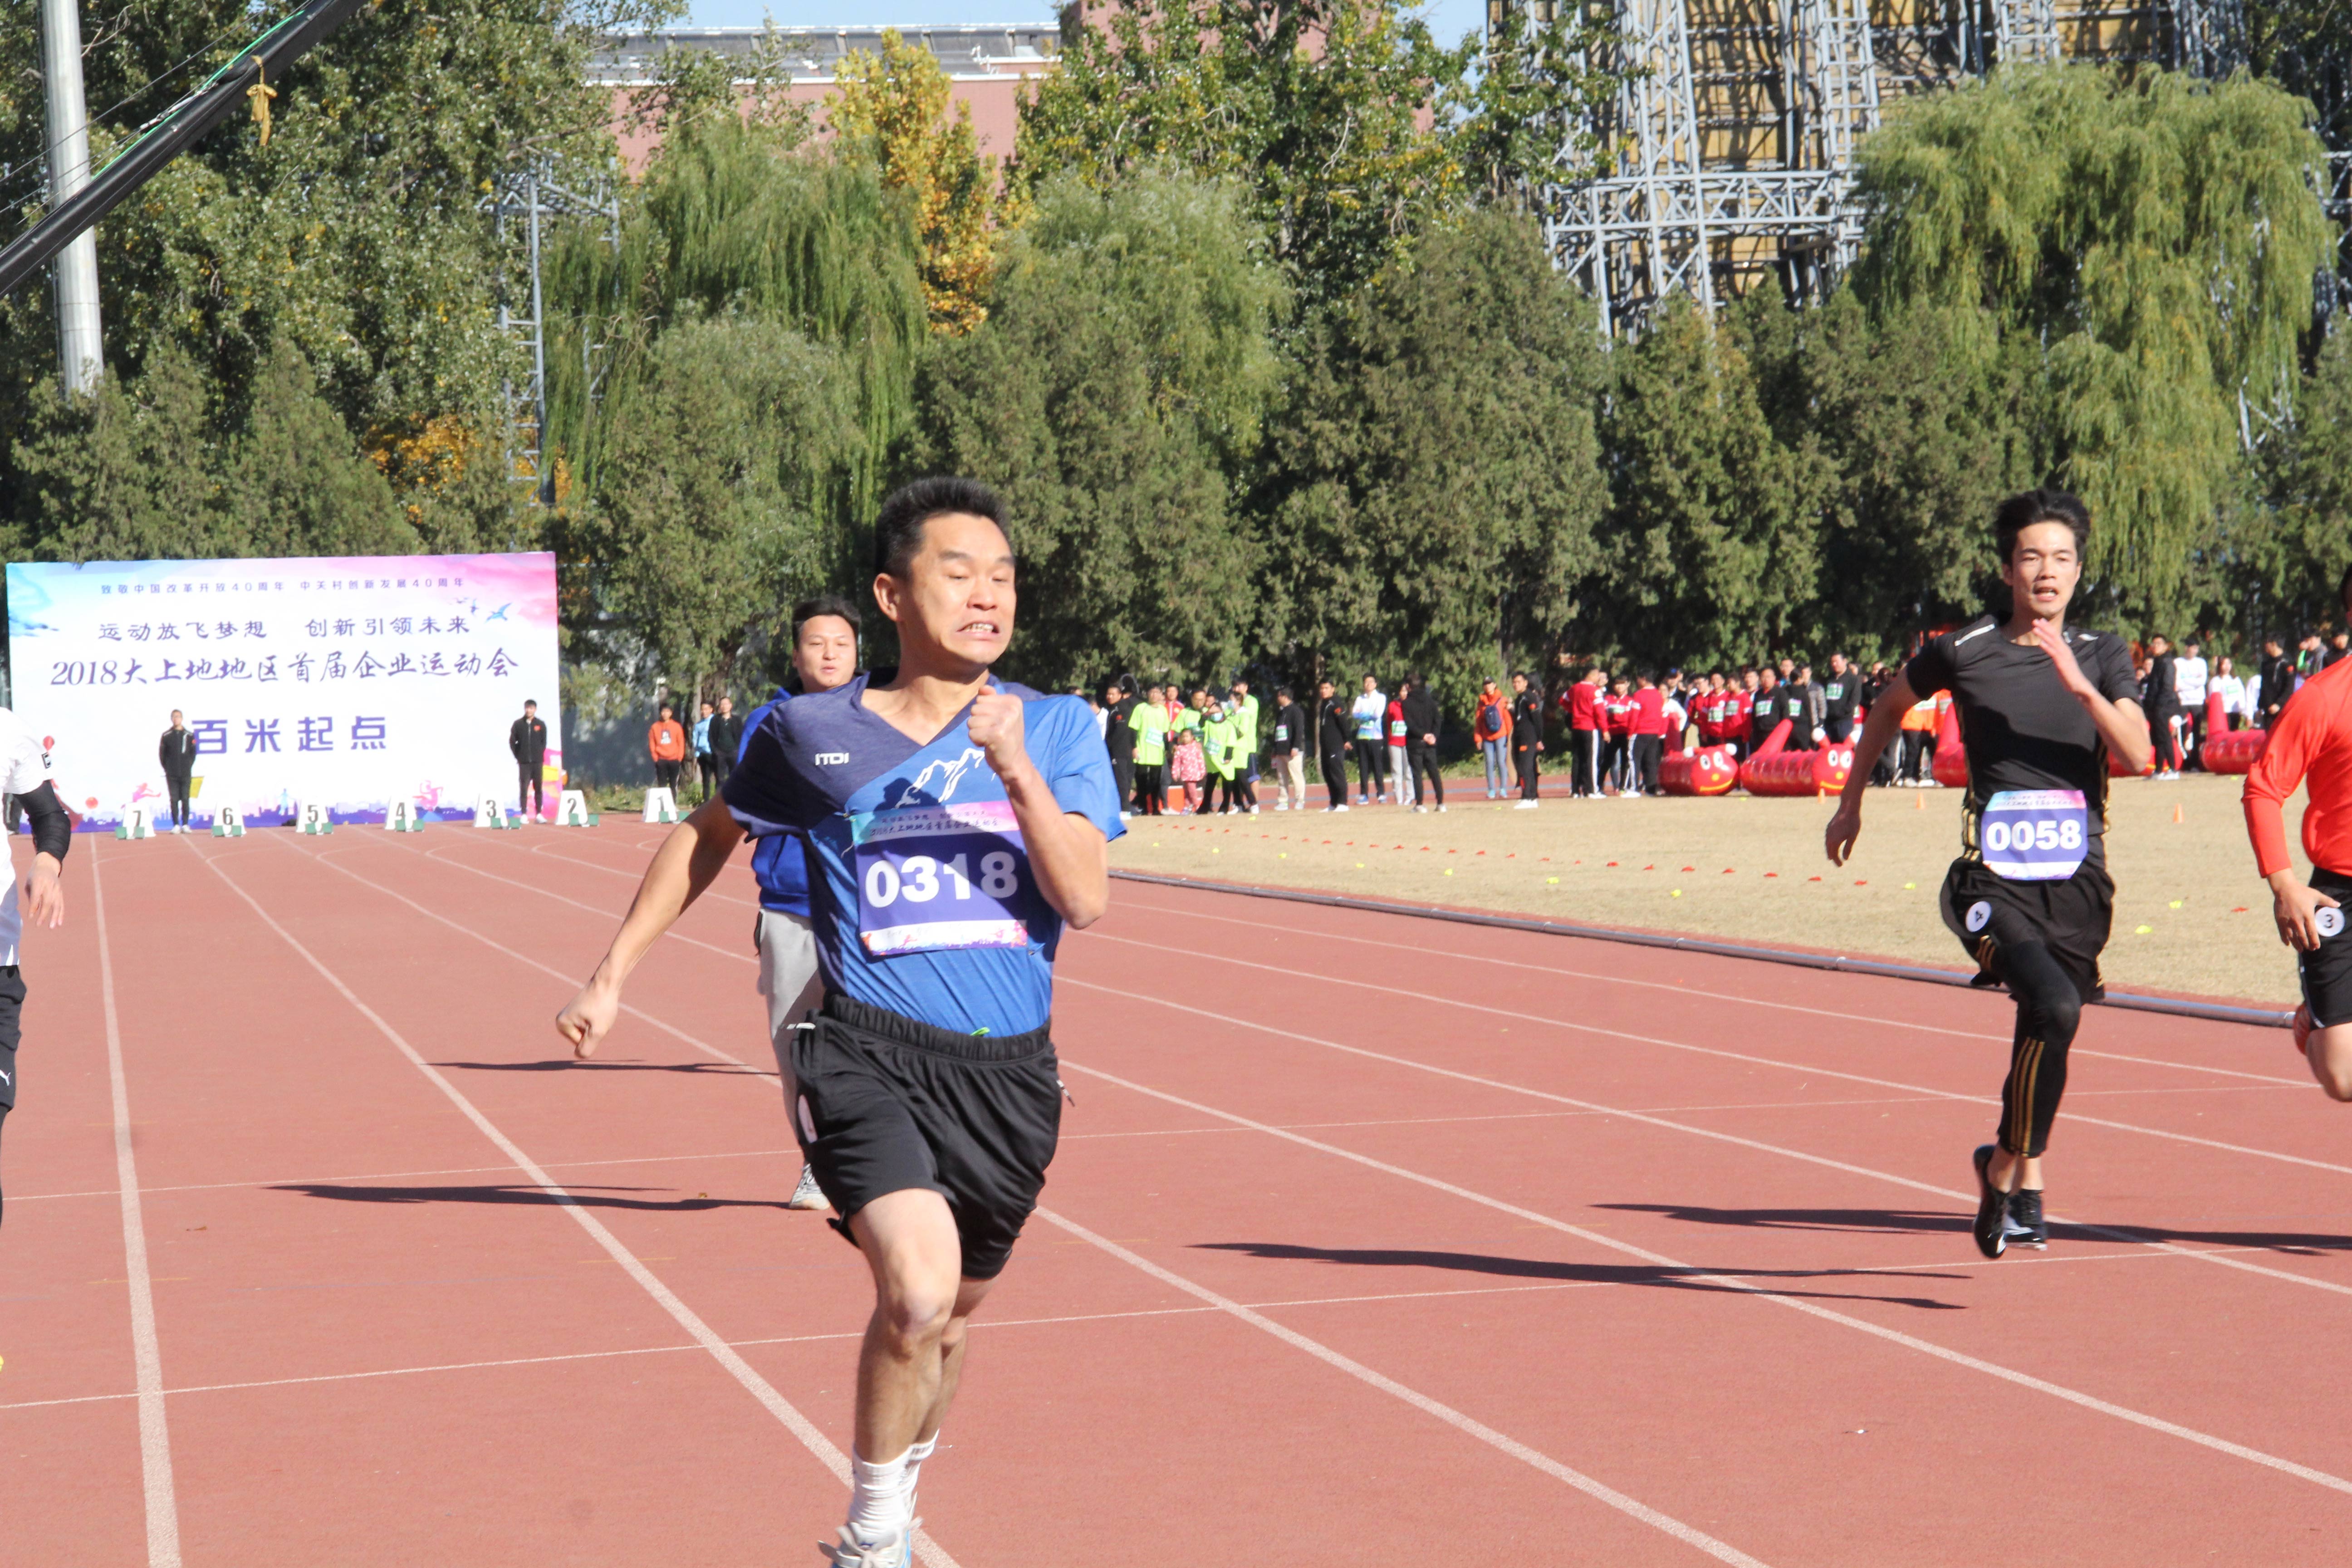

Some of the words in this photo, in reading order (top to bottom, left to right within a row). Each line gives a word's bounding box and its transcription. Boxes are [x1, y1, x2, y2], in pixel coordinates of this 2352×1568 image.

[98, 621, 267, 641] 运动放飞梦想
[305, 616, 470, 637] 创新引领未来
[51, 647, 519, 686] 2018大上地地区首届企业运动会
[191, 716, 386, 754] 百米起点
[396, 802, 407, 820] 4
[486, 800, 496, 817] 3
[567, 798, 577, 814] 2
[657, 795, 664, 811] 1
[222, 808, 233, 825] 6
[308, 804, 318, 822] 5
[1986, 819, 2082, 851] 0058
[865, 852, 1018, 908] 0318
[2323, 914, 2333, 929] 3
